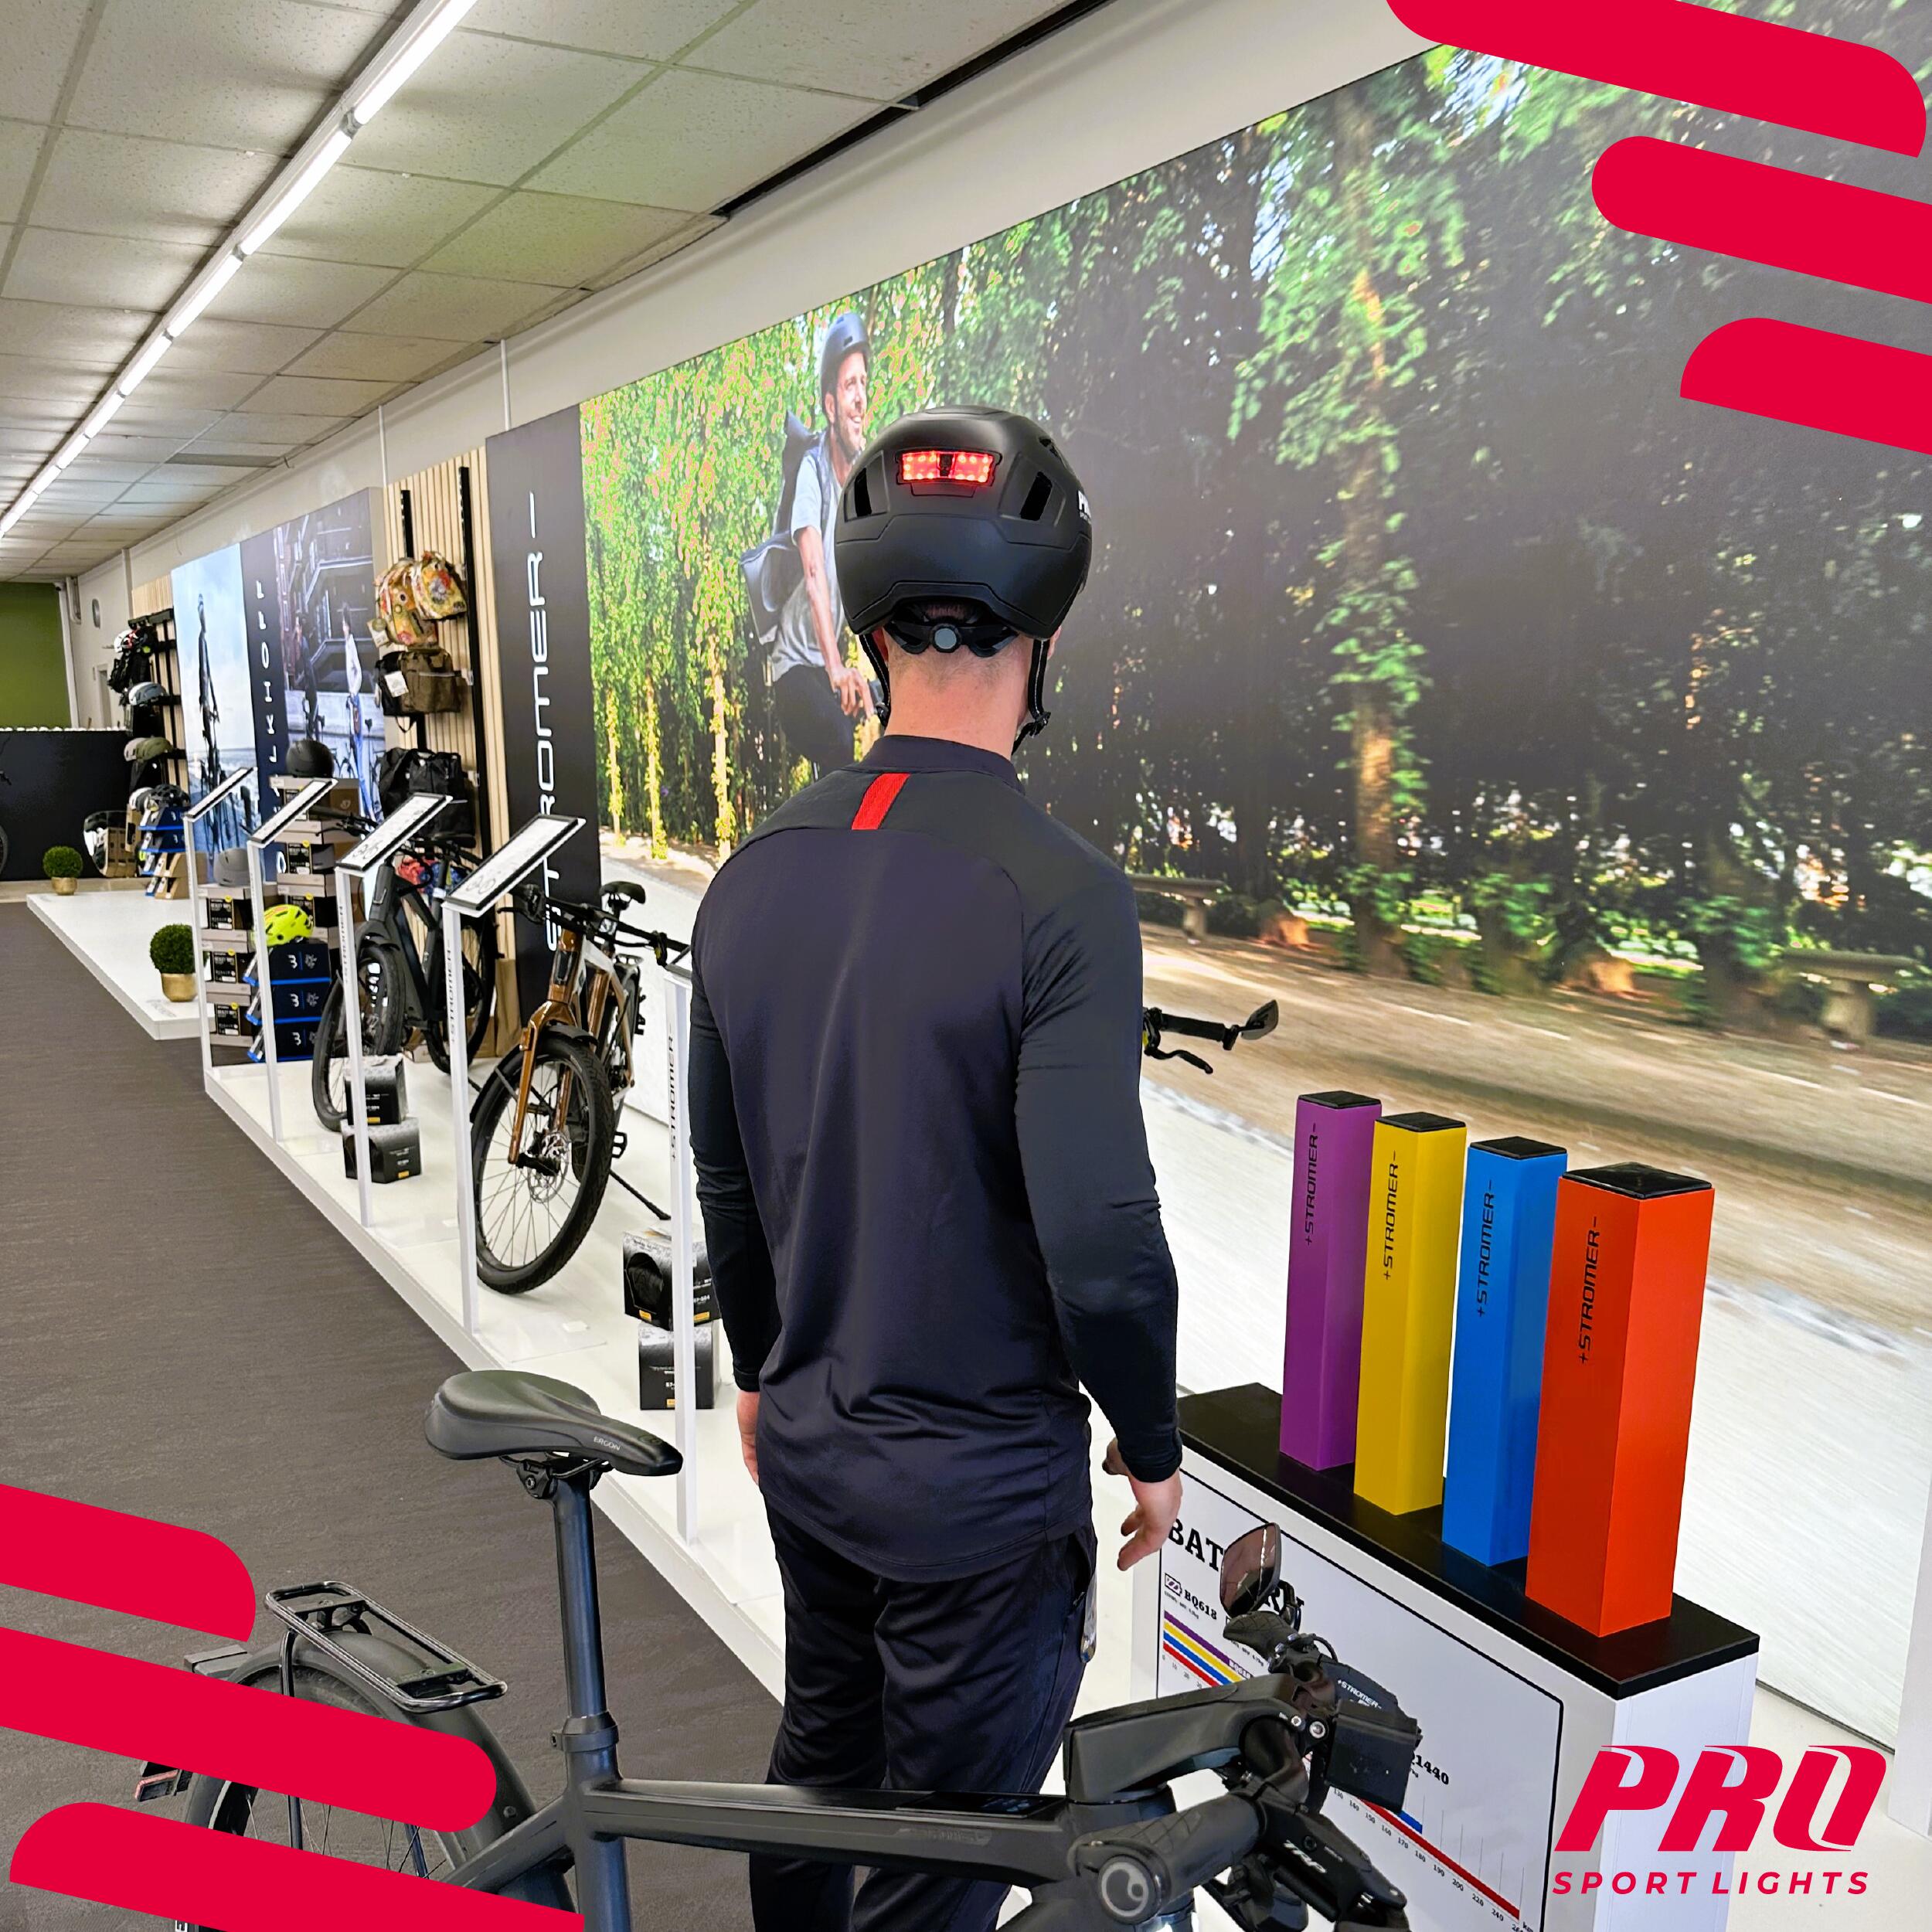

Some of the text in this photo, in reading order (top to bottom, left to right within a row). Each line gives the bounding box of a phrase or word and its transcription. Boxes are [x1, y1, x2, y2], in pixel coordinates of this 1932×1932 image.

[1184, 1589, 1217, 1621] BQ618
[1411, 1751, 1449, 1785] 1440
[1349, 1800, 1359, 1811] 140
[1365, 1812, 1376, 1824] 150
[1382, 1825, 1392, 1836] 160
[1398, 1837, 1409, 1849] 170
[1415, 1850, 1426, 1862] 180
[1434, 1864, 1445, 1877] 190
[1452, 1879, 1464, 1891] 200
[1472, 1893, 1484, 1906] 220
[1491, 1908, 1504, 1921] 240
